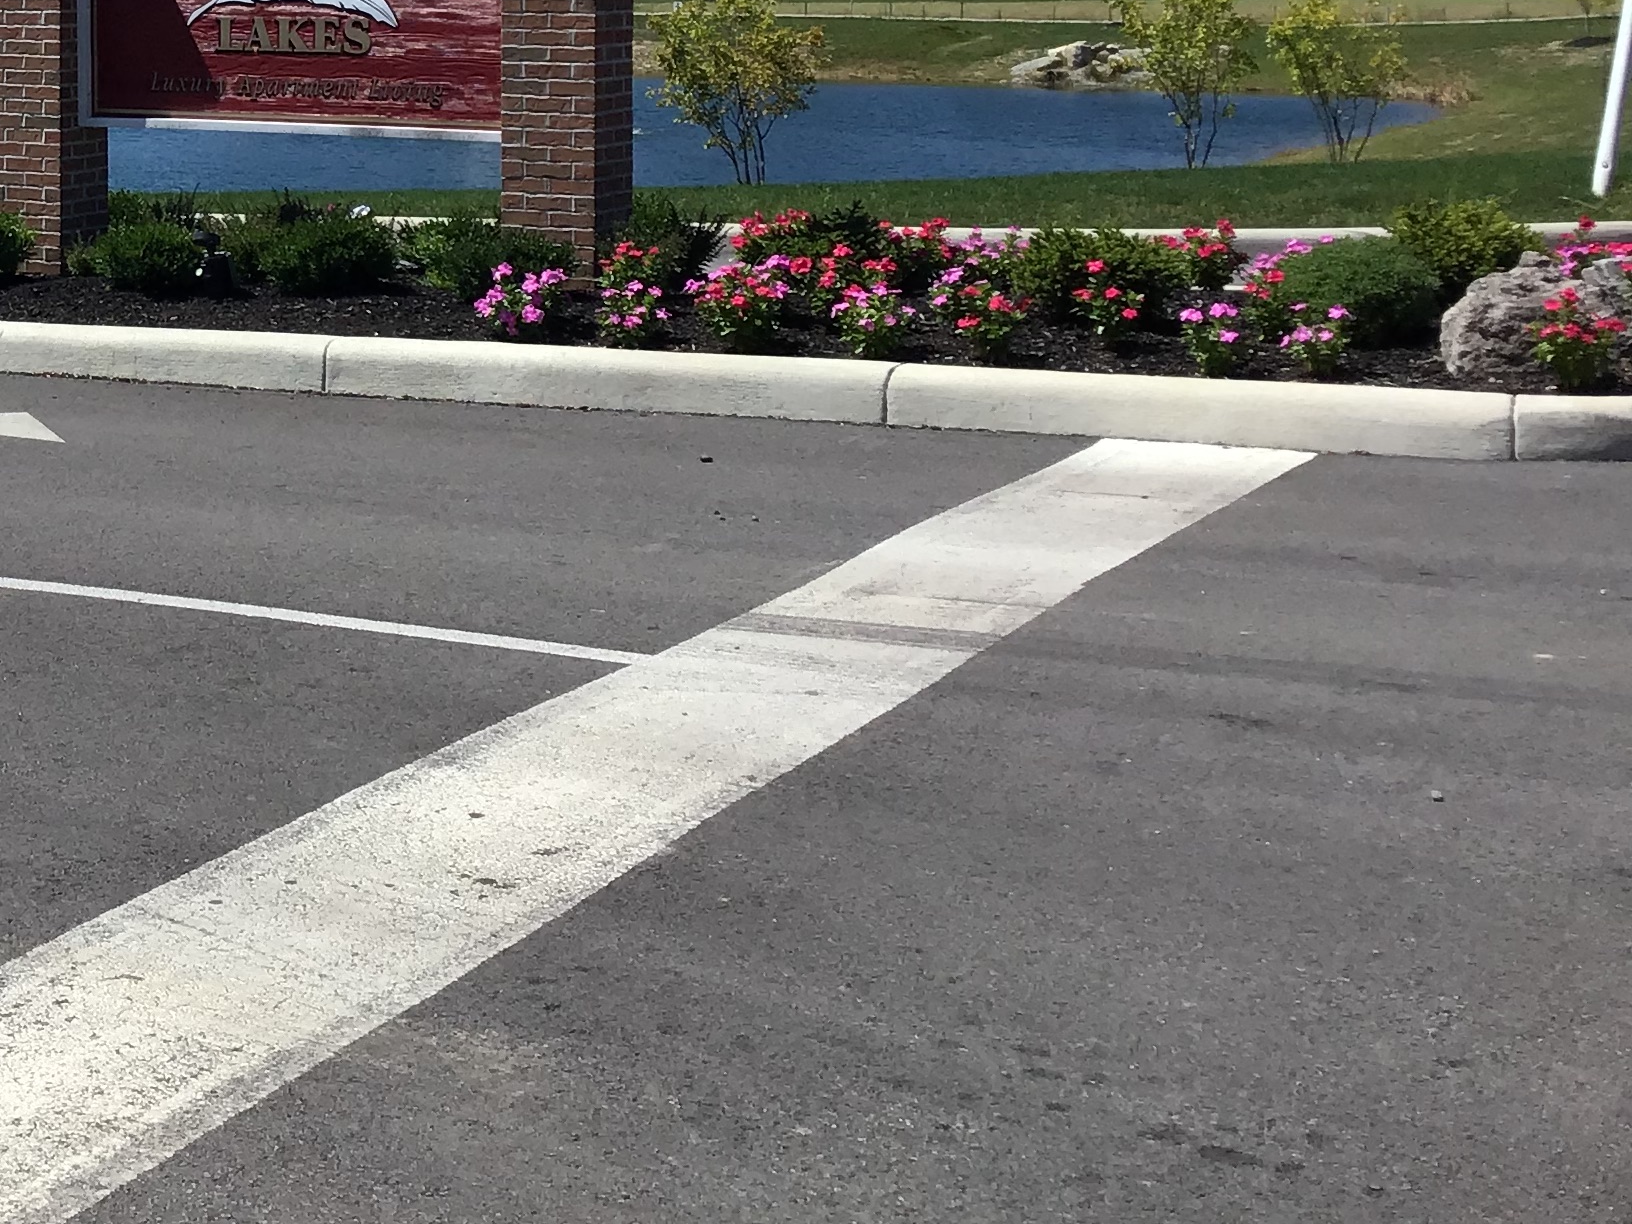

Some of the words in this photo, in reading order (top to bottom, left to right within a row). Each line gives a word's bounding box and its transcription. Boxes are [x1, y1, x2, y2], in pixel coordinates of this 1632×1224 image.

[215, 16, 373, 55] LAKES
[150, 71, 225, 99] Luxury
[238, 74, 359, 102] Apartment
[369, 78, 445, 107] Living
